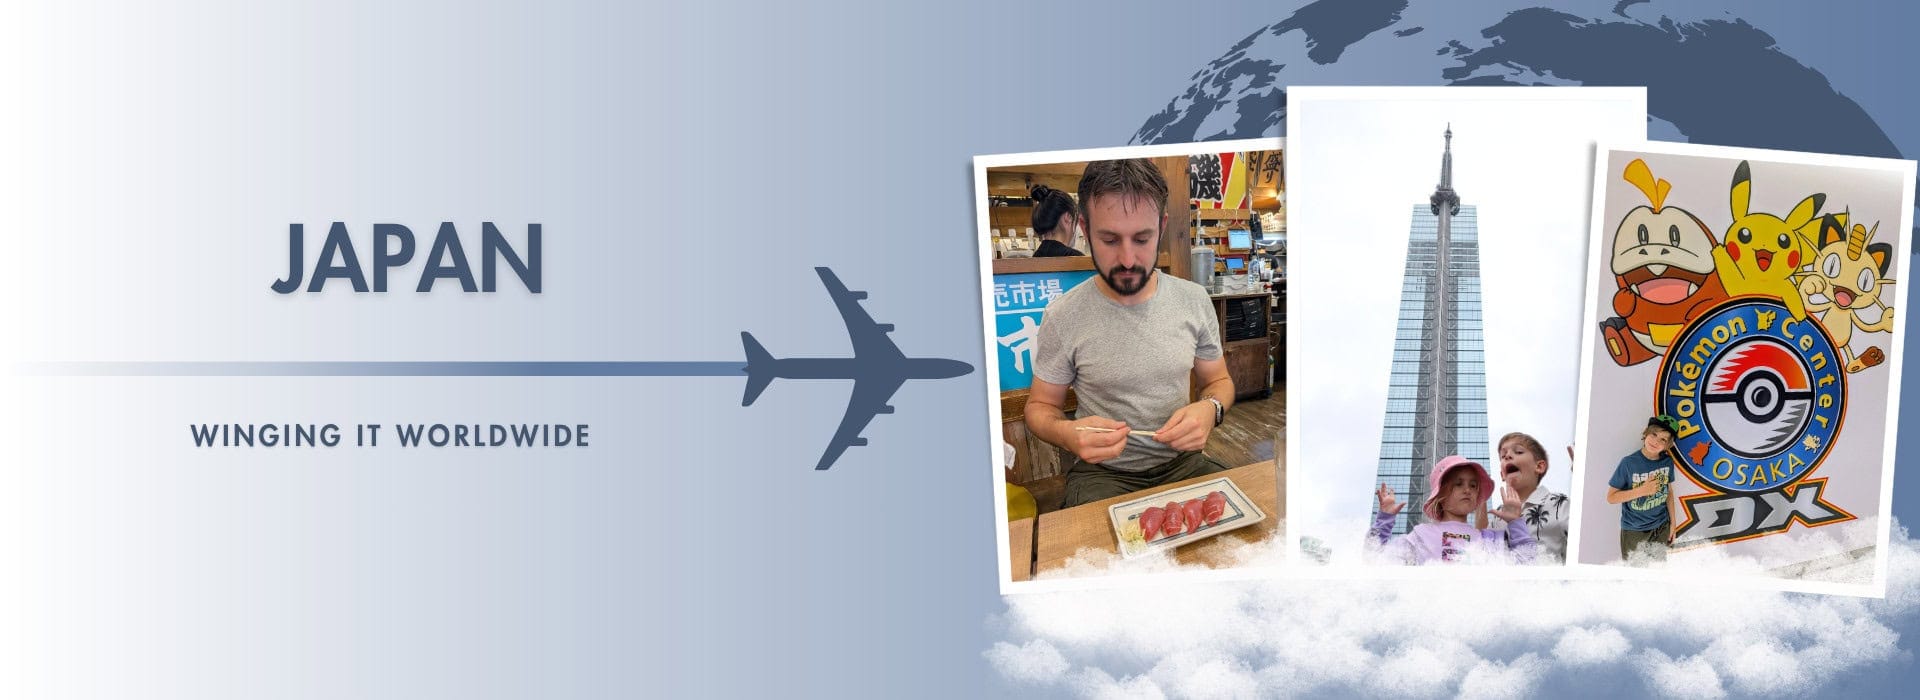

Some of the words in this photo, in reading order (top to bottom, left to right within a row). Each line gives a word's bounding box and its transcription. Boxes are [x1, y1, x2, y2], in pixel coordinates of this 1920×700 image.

[1670, 316, 1747, 439] Pokémon
[1781, 317, 1836, 429] Center
[1712, 453, 1805, 486] OSAKA
[1680, 486, 1835, 541] DX
